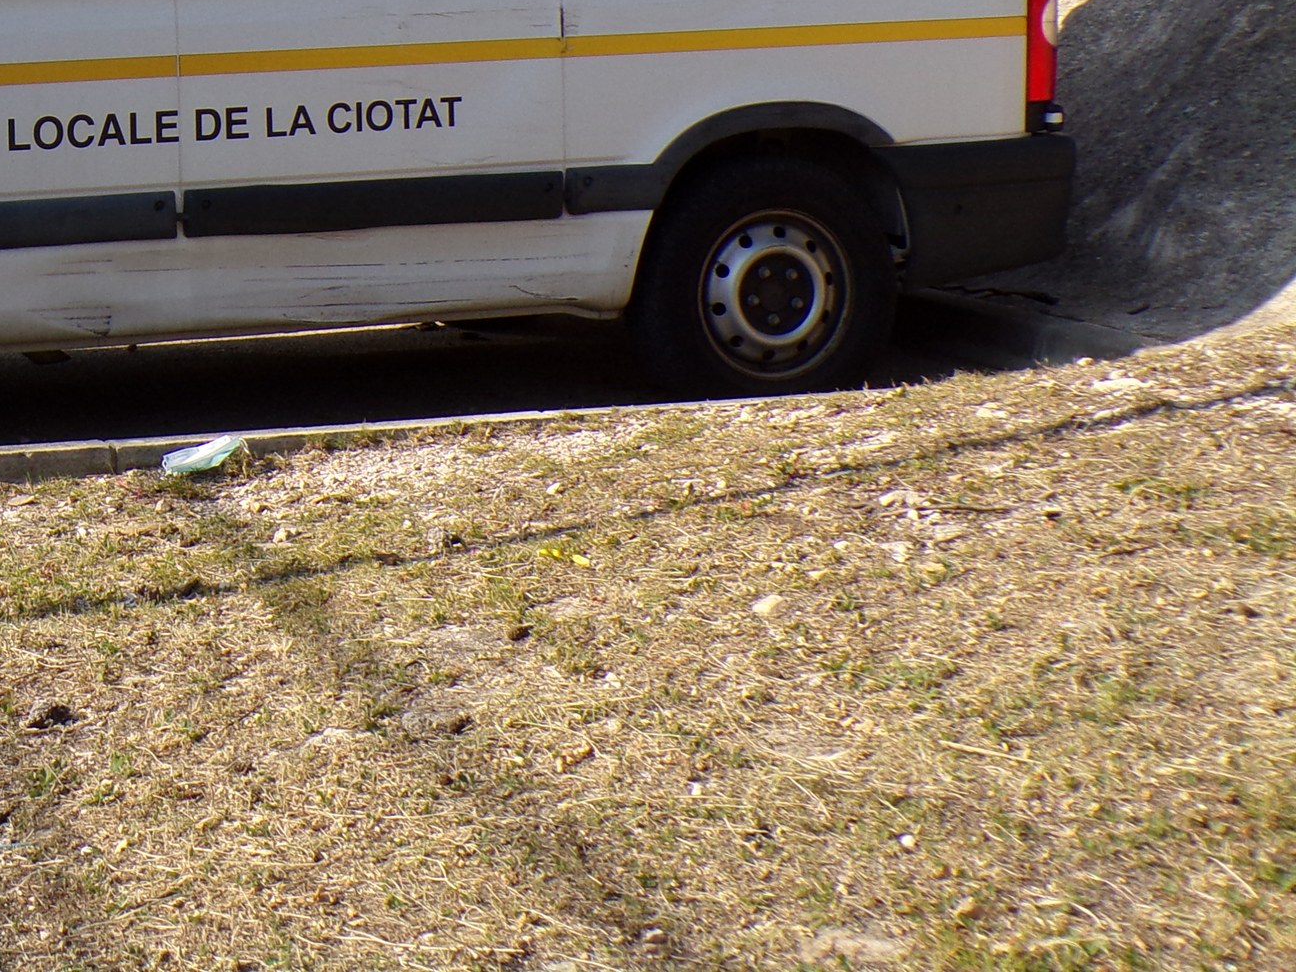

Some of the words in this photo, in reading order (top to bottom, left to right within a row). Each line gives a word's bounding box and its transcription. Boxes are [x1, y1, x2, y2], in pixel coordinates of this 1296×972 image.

[7, 109, 180, 152] LOCALE
[195, 106, 250, 142] DE
[265, 104, 317, 138] LA
[327, 96, 463, 134] CIOTAT
